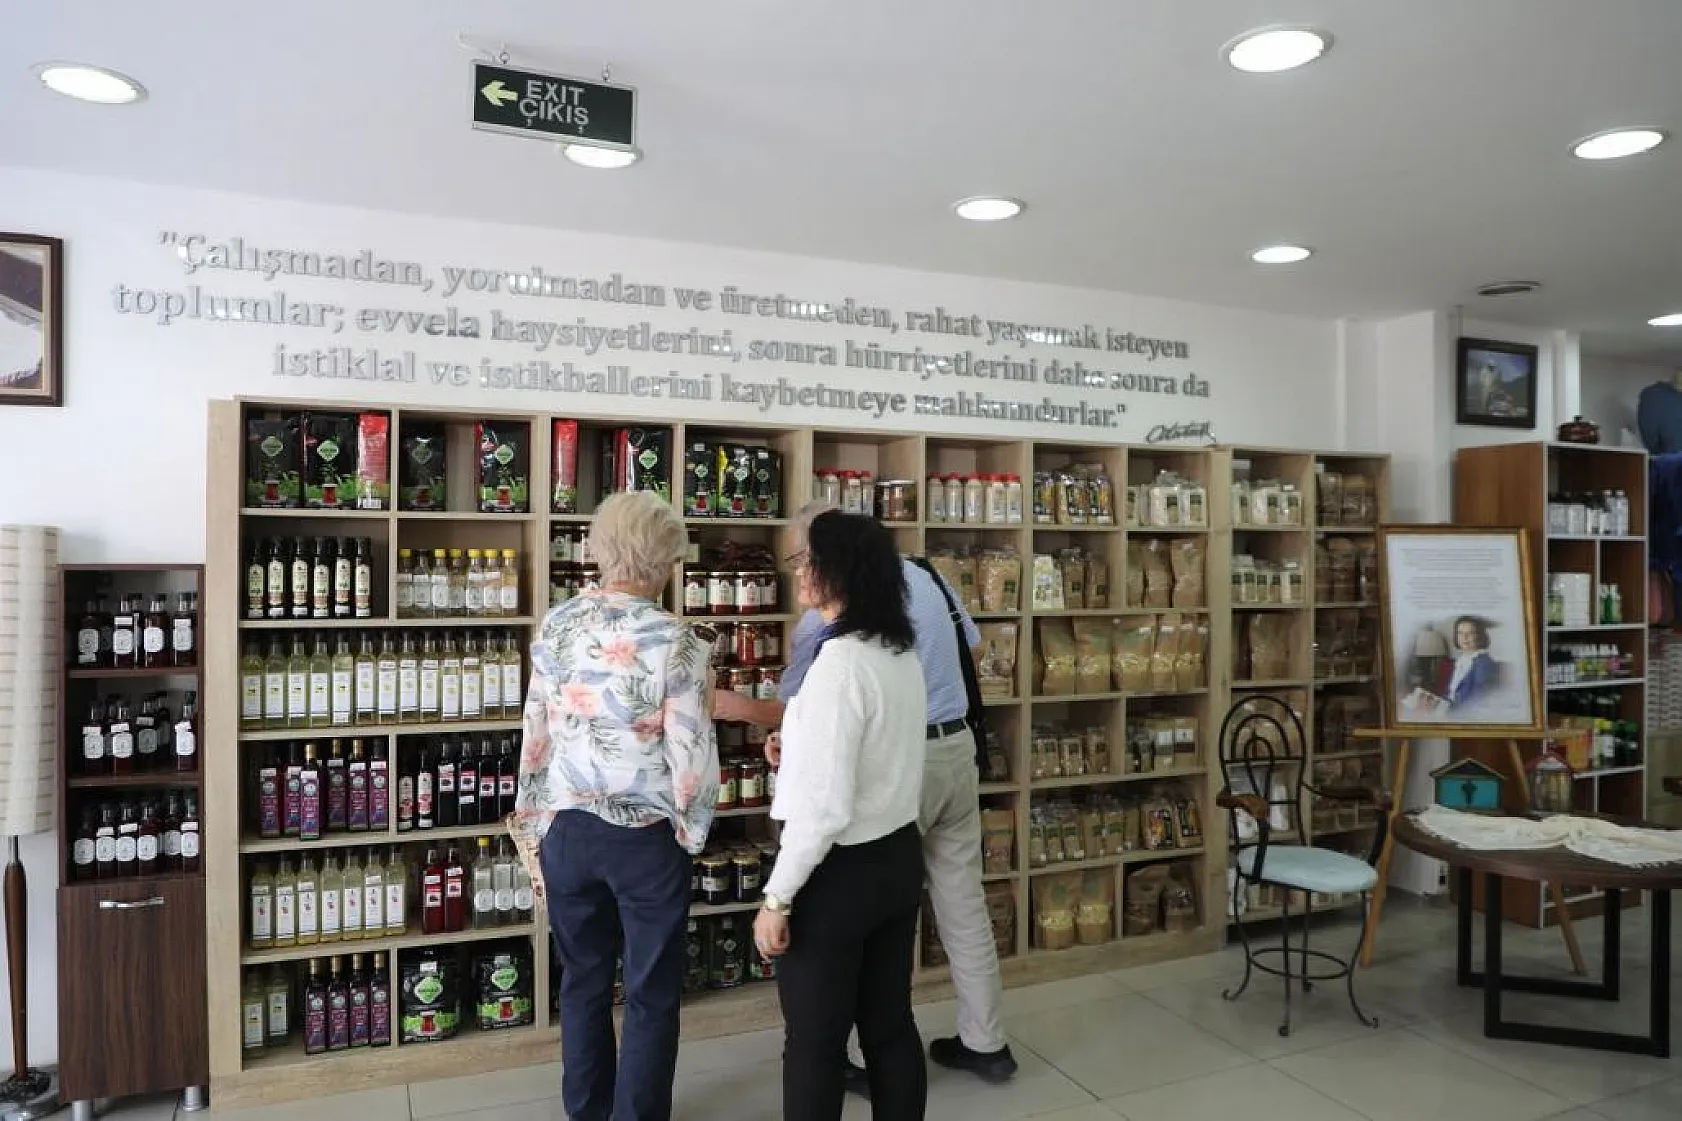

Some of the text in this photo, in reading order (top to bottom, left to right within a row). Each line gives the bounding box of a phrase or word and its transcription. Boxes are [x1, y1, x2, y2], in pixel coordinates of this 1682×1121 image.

[519, 98, 589, 134] ÇIKIŞ
[527, 80, 585, 105] EXIT
[158, 230, 1189, 362] "Çalışmadan, yorulmadan ve üretmeden, rahat yaşamak isteyen
[113, 283, 1210, 398] toplumlar; evvela haysiyetlerini, sonra hürriyetlerini daha sonra da
[272, 342, 415, 382] istiklal
[425, 360, 472, 388] ve
[479, 357, 712, 400] istikballerini
[720, 372, 906, 418] kaybetmeye
